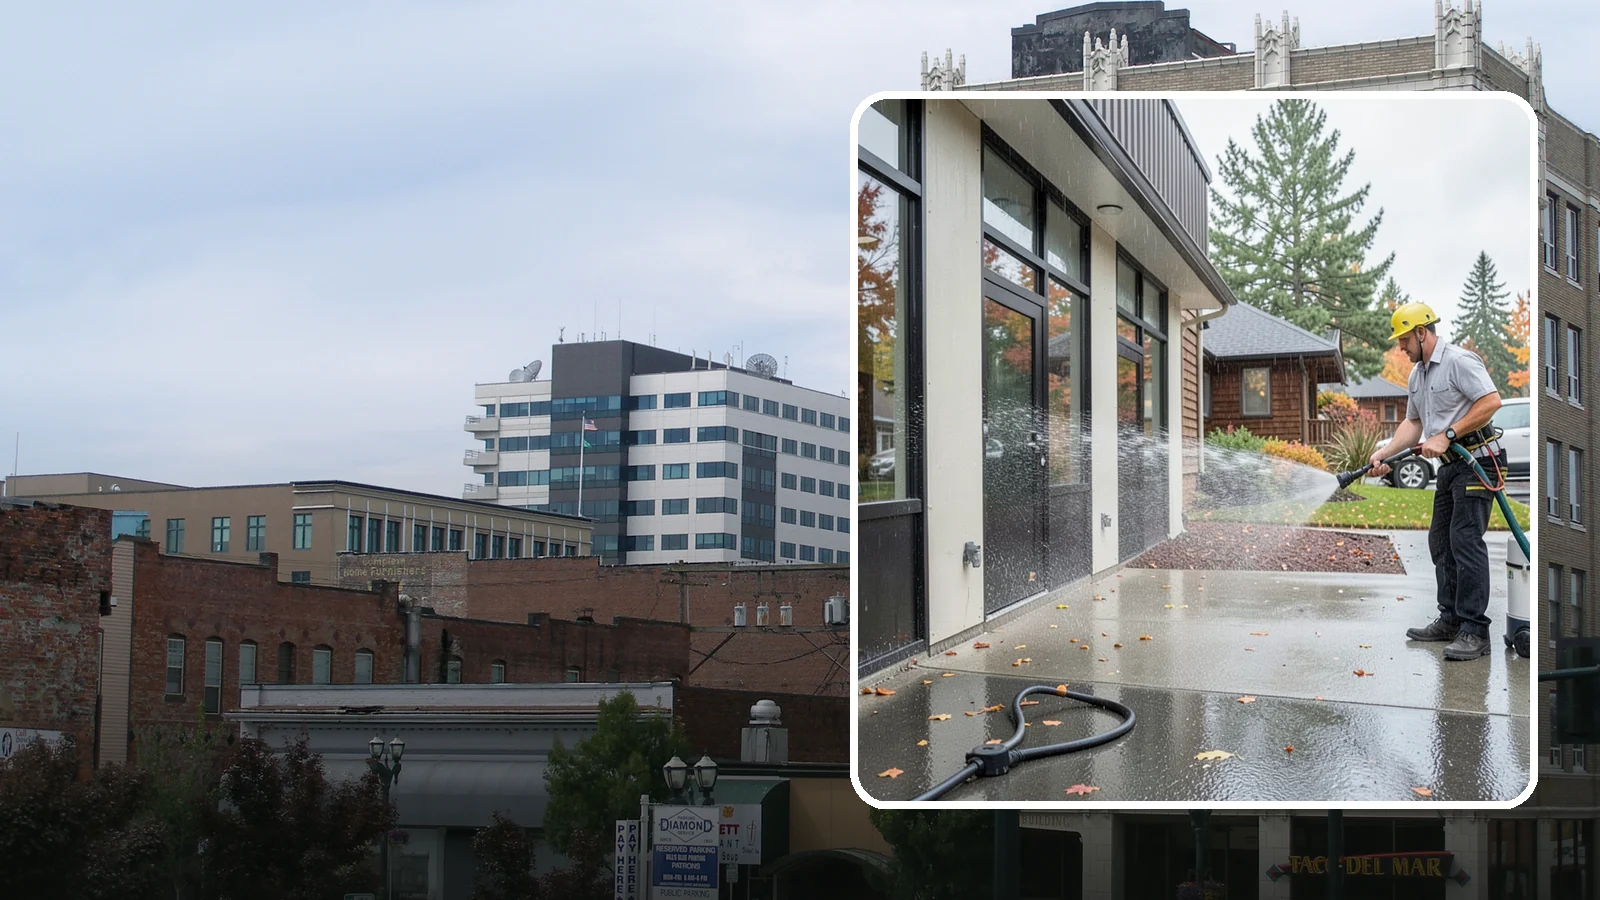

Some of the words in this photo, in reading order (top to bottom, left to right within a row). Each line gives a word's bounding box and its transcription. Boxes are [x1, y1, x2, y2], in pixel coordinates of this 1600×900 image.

[343, 568, 367, 577] Home
[370, 565, 427, 577] Furnishers
[660, 818, 713, 833] DIAMOND
[1022, 815, 1070, 828] BUILDING
[617, 824, 625, 852] PAY
[628, 824, 637, 853] PAY
[656, 845, 688, 853] RESERVED
[721, 852, 739, 862] Soup
[671, 862, 701, 870] PATRONS
[1346, 856, 1385, 876] DEL
[1392, 857, 1442, 877] MAR
[616, 856, 625, 893] HERE
[627, 855, 636, 893] HERE
[660, 888, 682, 898] PUBLIC
[683, 889, 710, 898] PARKING
